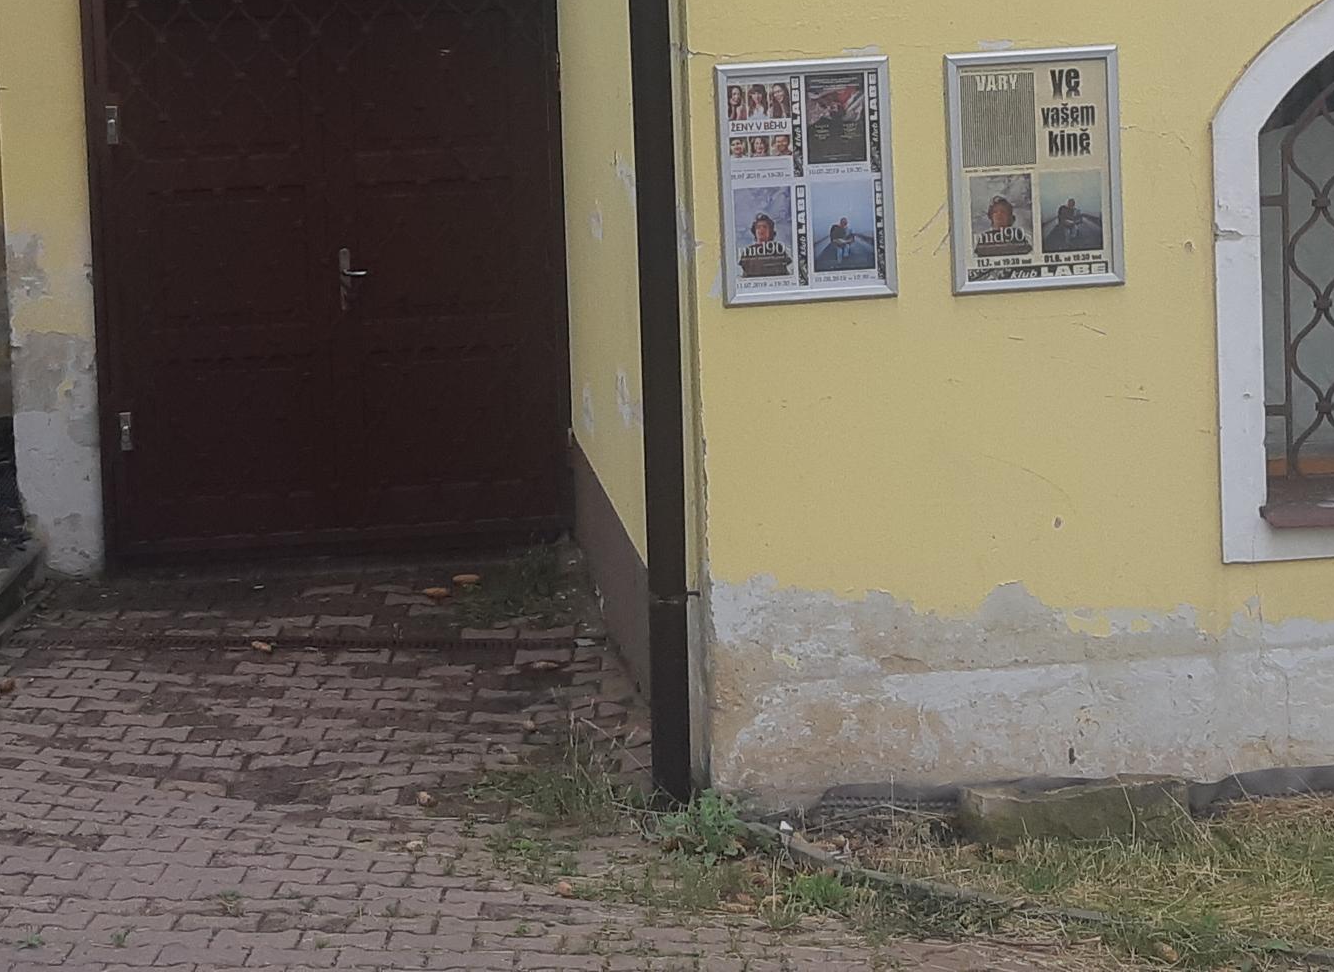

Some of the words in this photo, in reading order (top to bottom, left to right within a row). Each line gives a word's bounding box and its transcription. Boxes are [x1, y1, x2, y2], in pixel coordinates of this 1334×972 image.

[975, 74, 1018, 92] VARY
[1040, 103, 1096, 128] vašem
[1048, 128, 1091, 156] kině
[1009, 269, 1038, 279] klub
[1040, 263, 1106, 277] LABE
